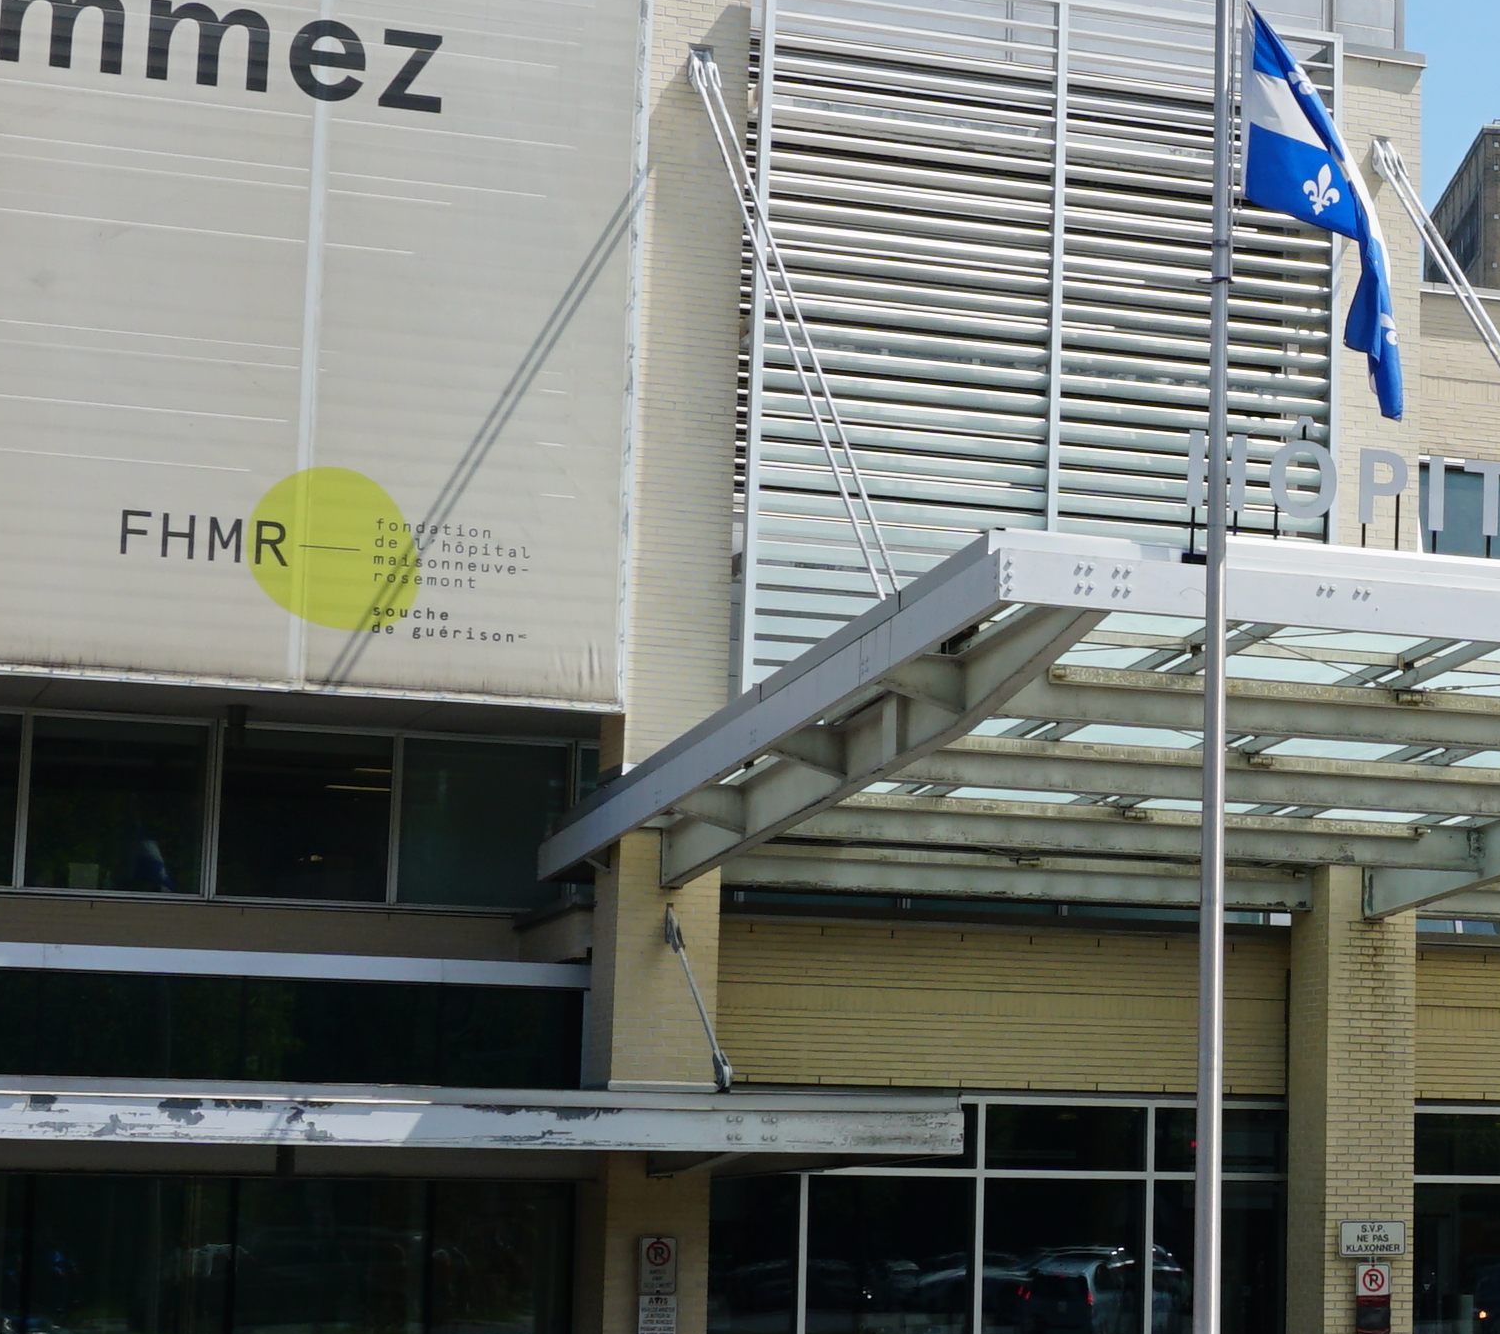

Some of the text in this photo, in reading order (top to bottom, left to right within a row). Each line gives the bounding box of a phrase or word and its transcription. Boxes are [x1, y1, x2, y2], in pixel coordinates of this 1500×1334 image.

[375, 518, 492, 540] fondation
[119, 509, 289, 567] FHMR
[374, 535, 398, 549] de
[373, 554, 529, 575] maisonneuve-
[373, 572, 477, 589] rosemont
[372, 606, 450, 621] souche
[371, 621, 395, 635] de
[1356, 1234, 1389, 1243] NE PAS
[1345, 1243, 1401, 1253] KLAXONNER
